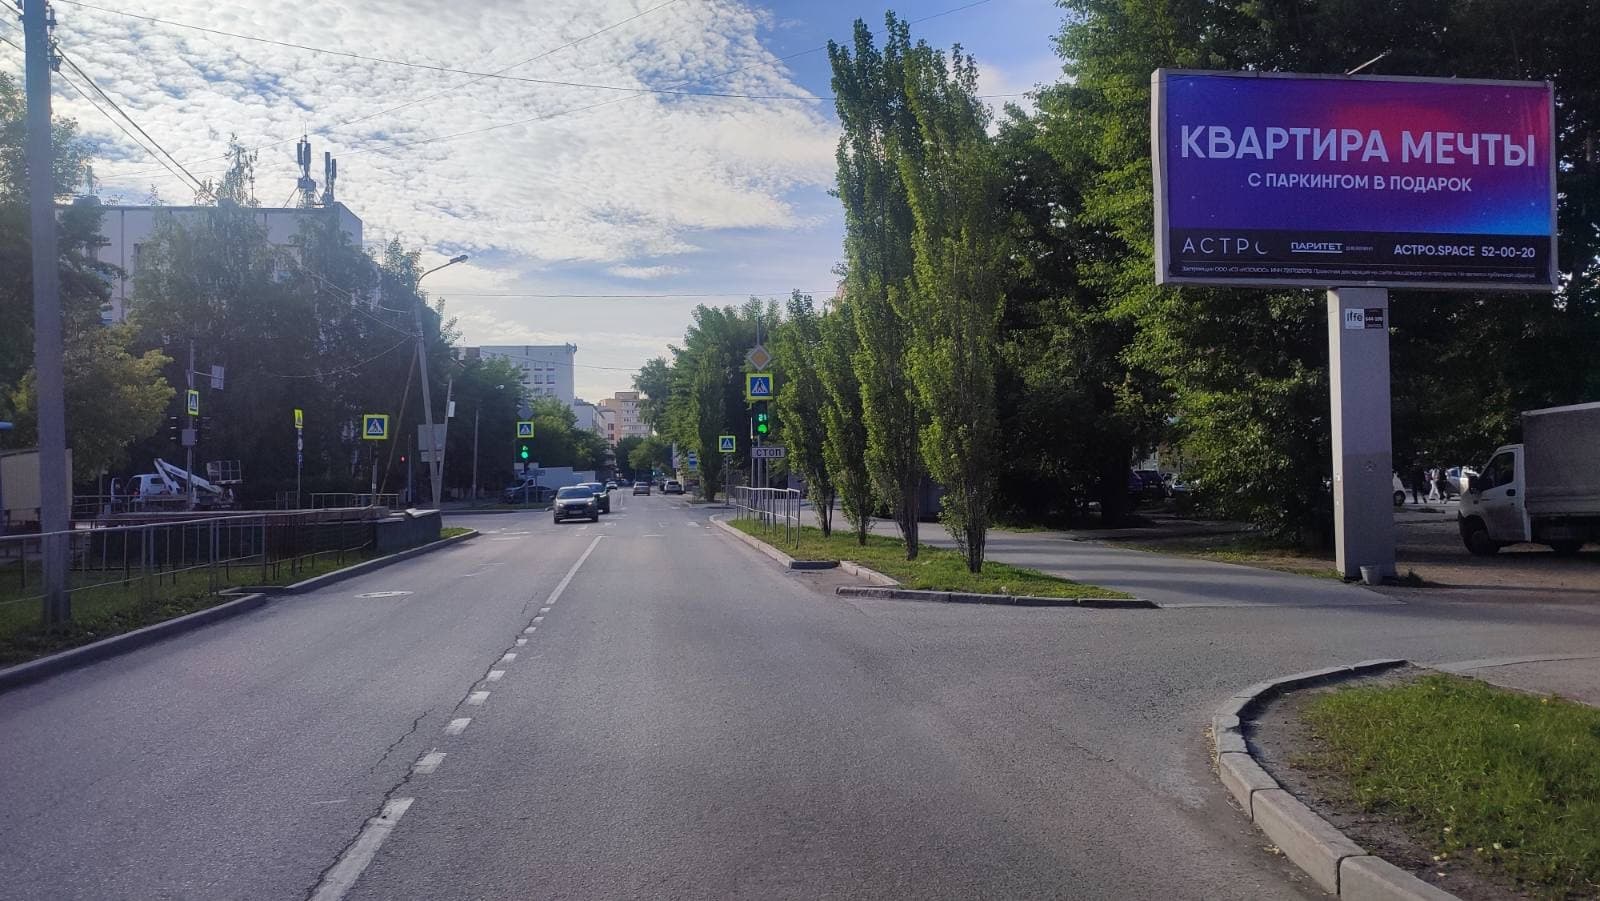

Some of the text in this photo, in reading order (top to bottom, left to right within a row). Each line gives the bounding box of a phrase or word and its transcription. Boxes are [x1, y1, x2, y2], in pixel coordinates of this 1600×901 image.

[1181, 125, 1535, 166] КВАРТИРА МЕЧТЫ
[1247, 172, 1472, 192] С ПАРКИНГОМ В ПОДАРОК
[1291, 242, 1343, 251] ПАРИТЕТ
[1481, 246, 1536, 258] 52-00-20
[756, 449, 782, 457] СТОП
